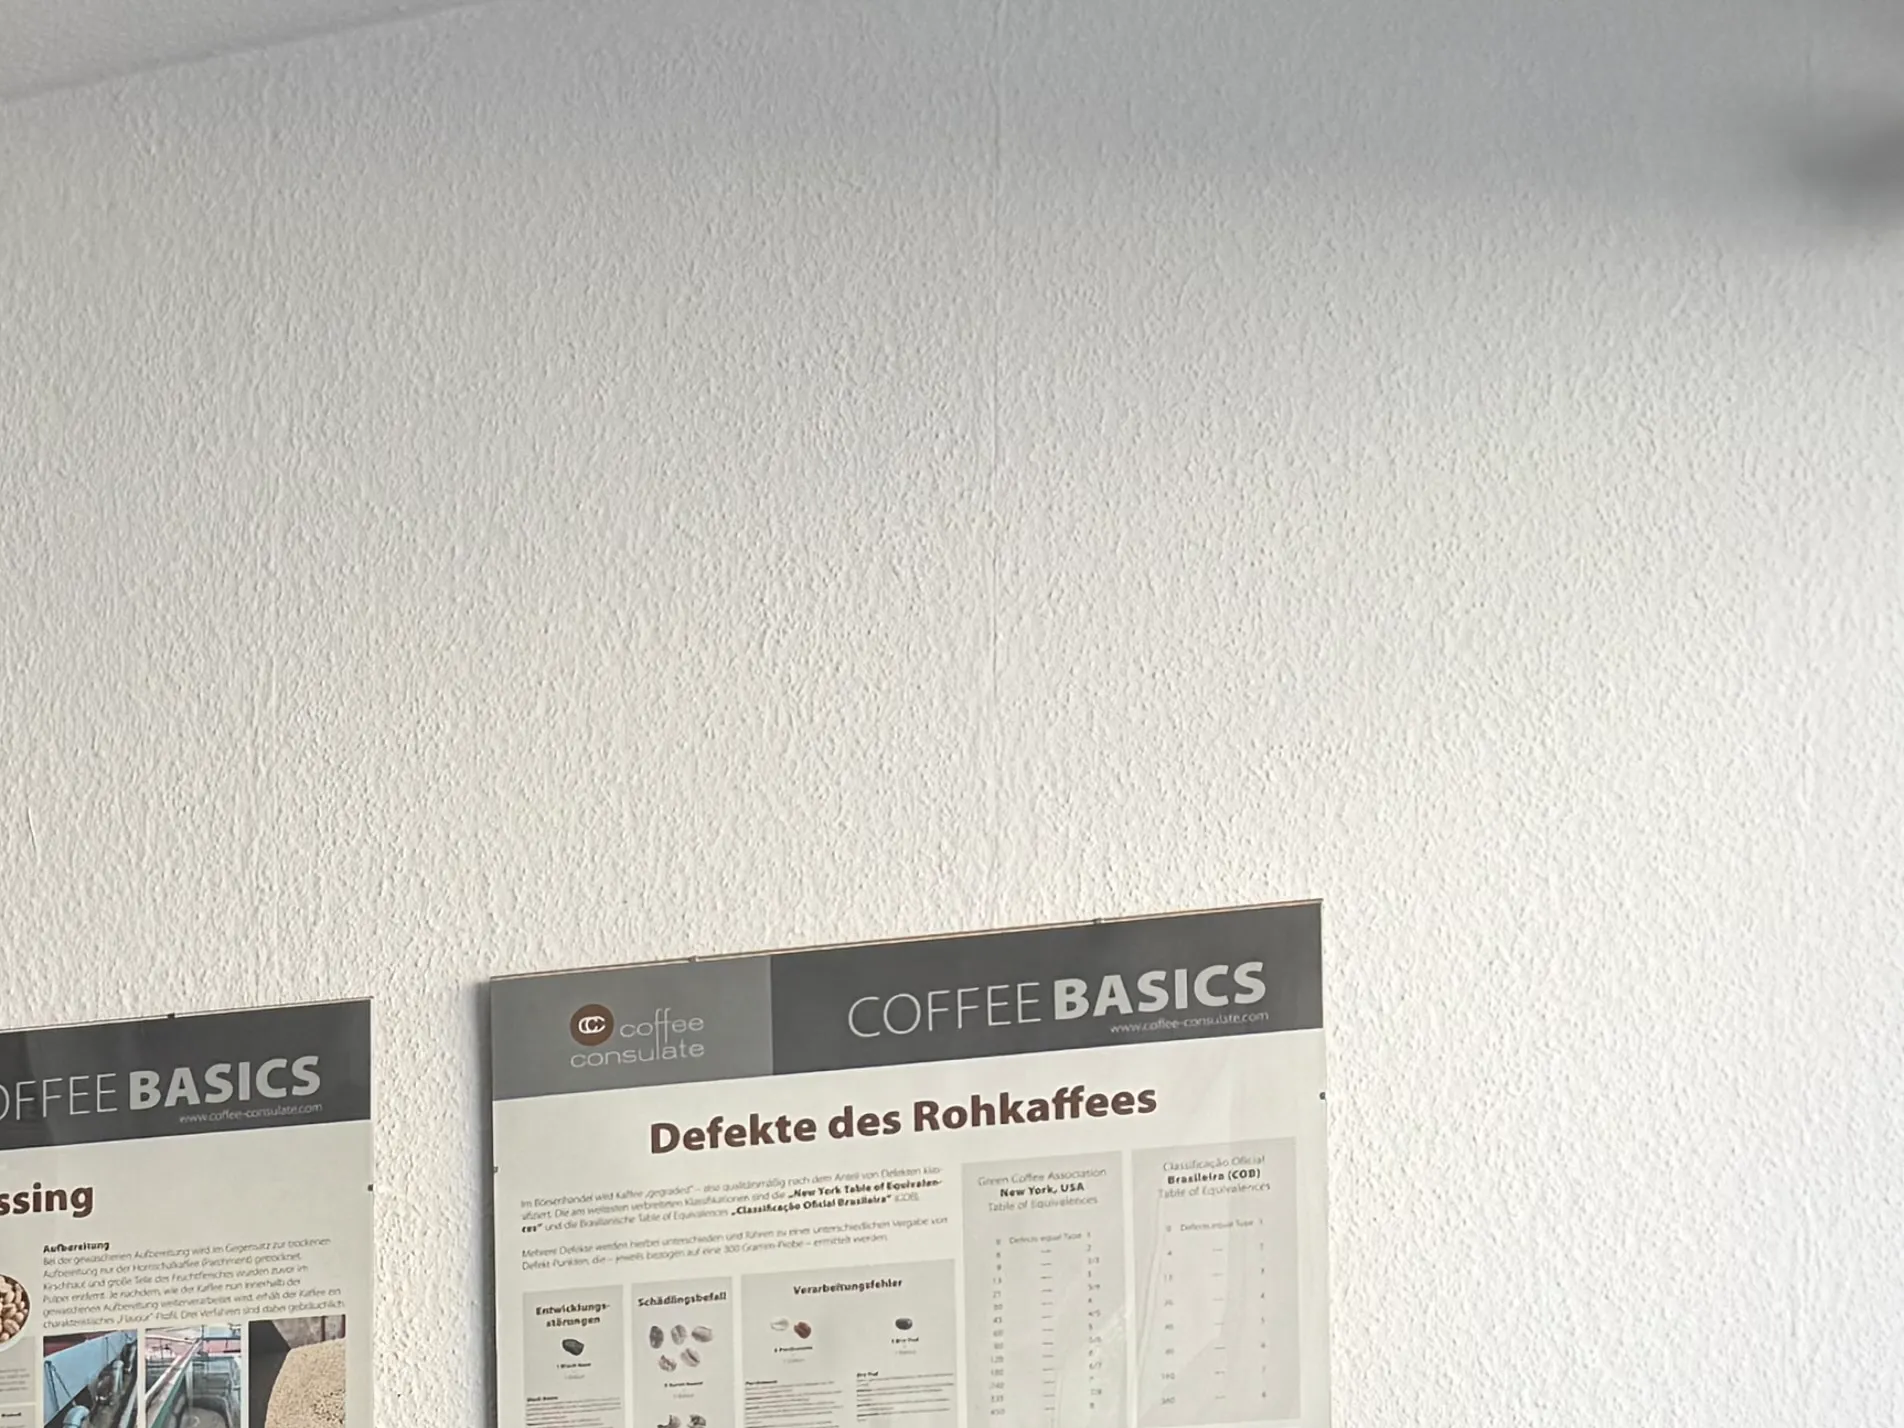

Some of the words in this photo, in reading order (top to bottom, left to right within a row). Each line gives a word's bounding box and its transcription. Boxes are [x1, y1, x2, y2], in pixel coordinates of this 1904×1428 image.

[847, 982, 1041, 1039] COFFEE
[1053, 961, 1267, 1020] BASICS
[620, 1008, 705, 1048] coffee
[1110, 1010, 1269, 1034] www.coffee-consulate.com
[570, 1038, 705, 1069] consulate
[129, 1055, 322, 1111] BASICS
[178, 1102, 323, 1125] www.coffee-consulate.com
[650, 1113, 818, 1154] Defekte
[827, 1103, 902, 1139] des
[913, 1085, 1157, 1132] Rohkaffees
[1012, 1172, 1045, 1184] Coffee
[1227, 1168, 1261, 1181] (COB)
[1000, 1187, 1025, 1197] New
[1028, 1185, 1057, 1196] York,
[1061, 1182, 1085, 1193] USA
[43, 1241, 110, 1254] Aufbereitung
[638, 1291, 726, 1308] Schädlingsbefall
